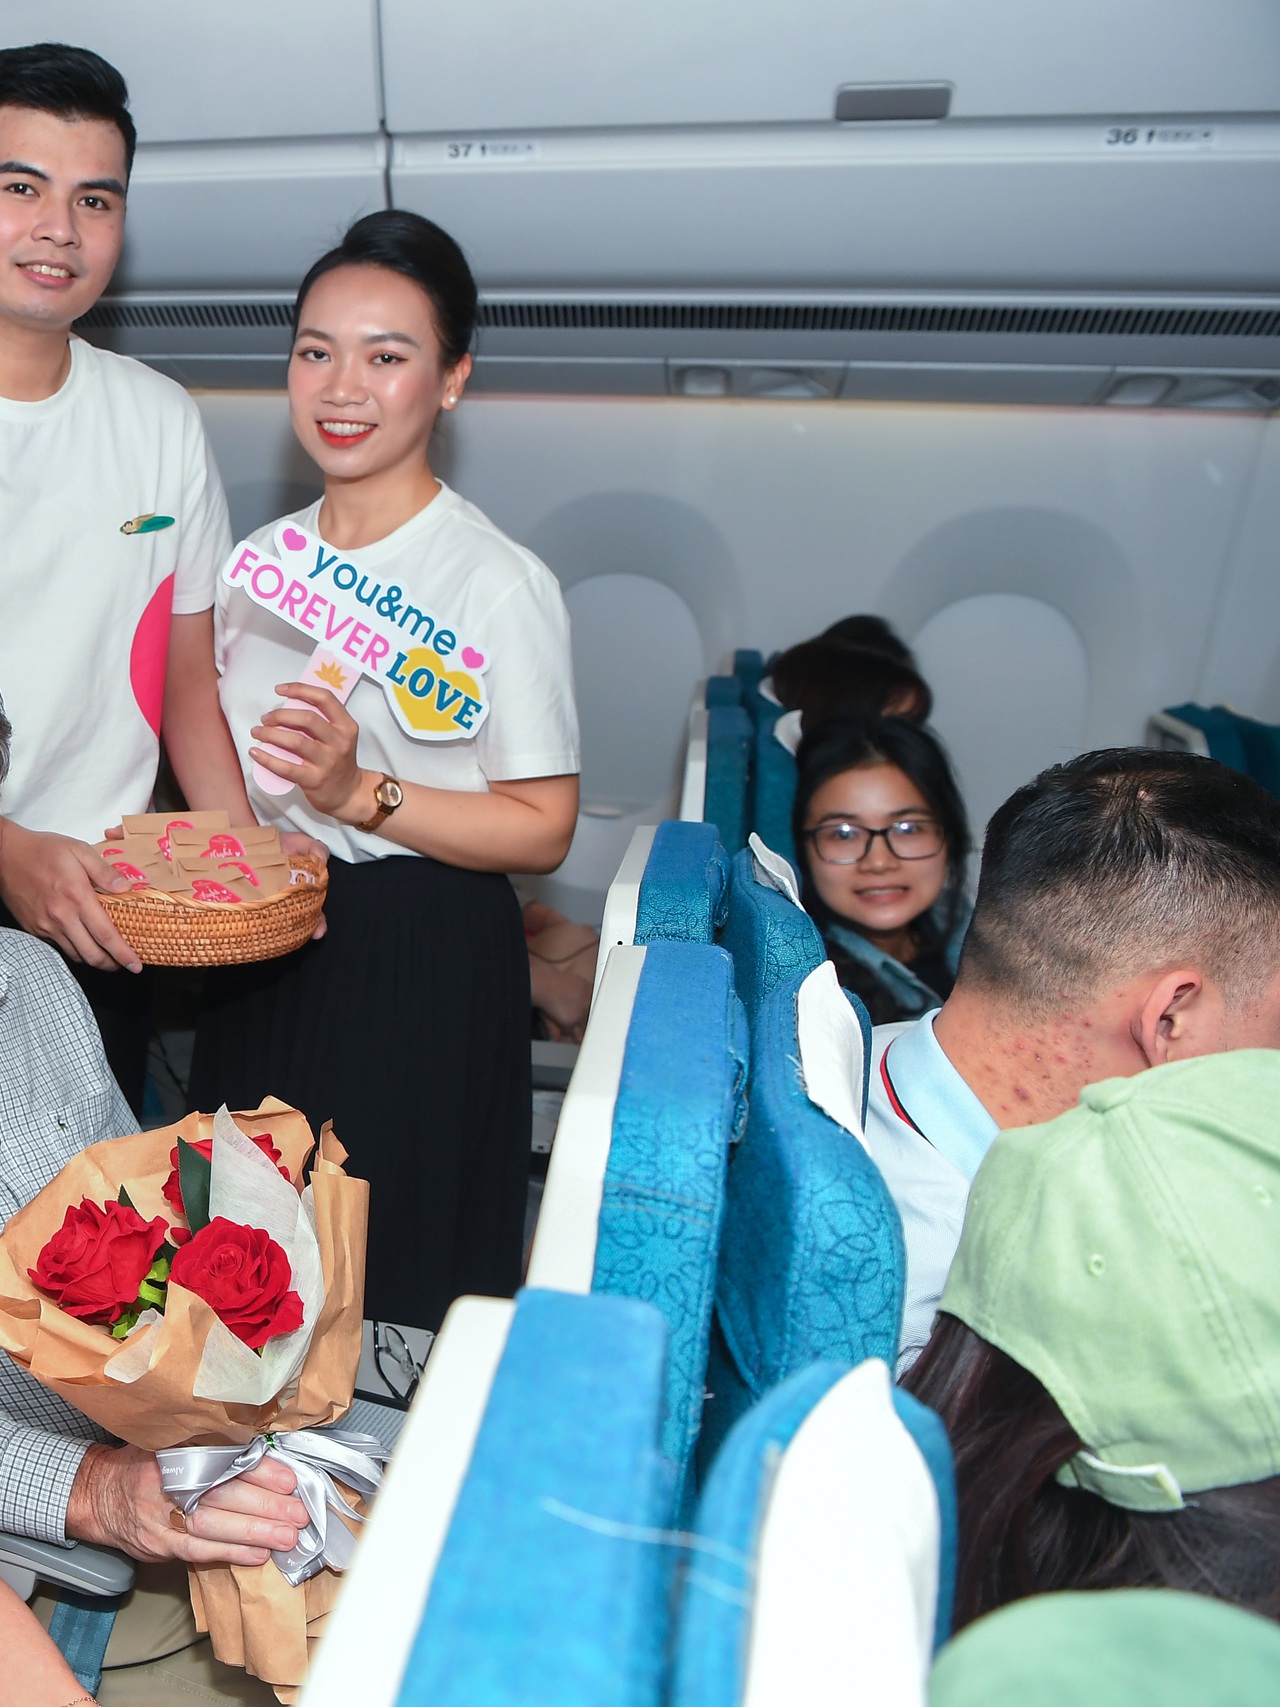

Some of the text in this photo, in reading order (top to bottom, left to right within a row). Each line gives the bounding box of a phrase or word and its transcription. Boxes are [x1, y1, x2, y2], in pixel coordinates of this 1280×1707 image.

[447, 143, 473, 158] 37
[1106, 128, 1138, 144] 36
[229, 548, 390, 671] FOREVER
[307, 545, 457, 655] you&me
[386, 651, 483, 730] LOVE
